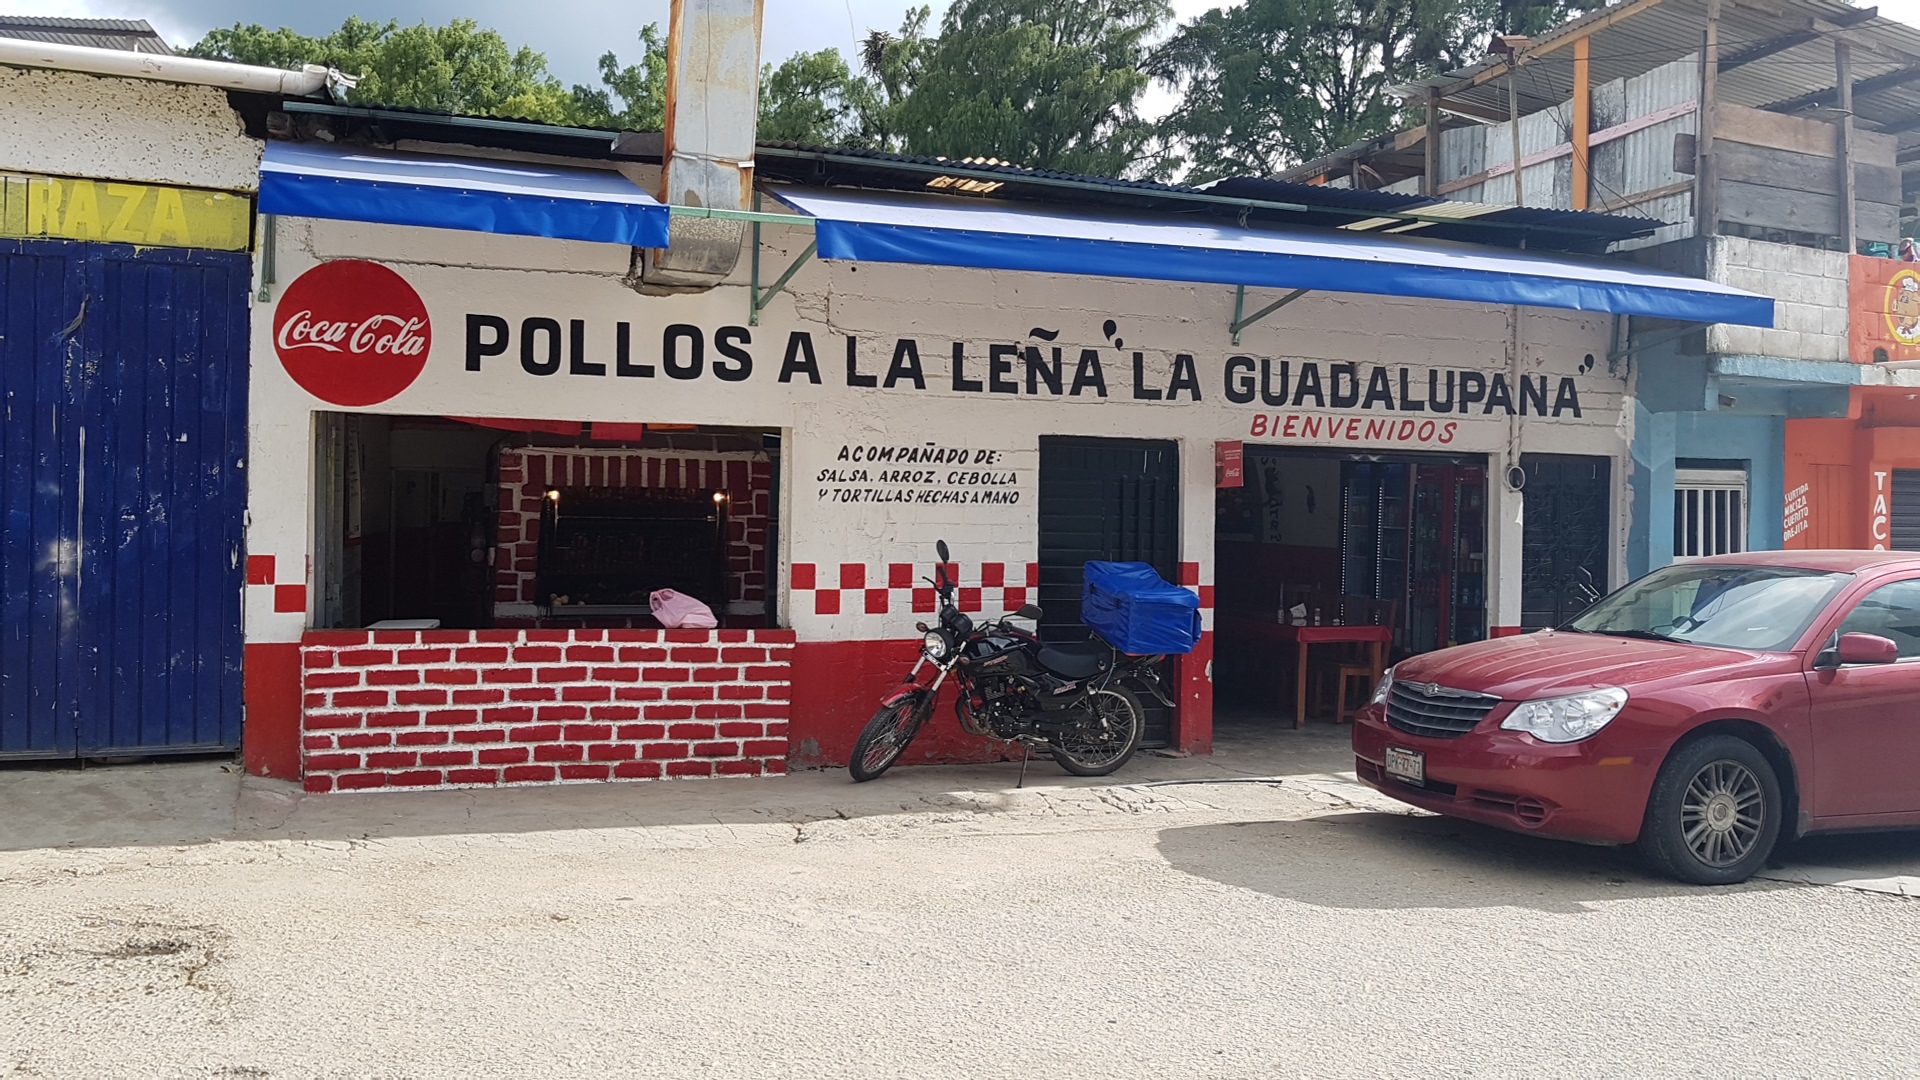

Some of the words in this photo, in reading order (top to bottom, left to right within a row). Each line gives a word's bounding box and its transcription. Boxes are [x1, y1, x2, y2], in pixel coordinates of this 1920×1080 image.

[28, 178, 191, 245] RAZA
[278, 310, 429, 356] Coca-Cola
[465, 313, 753, 382] POLLOS
[778, 331, 822, 385] A
[846, 336, 926, 390] LA
[952, 327, 1108, 398] LEÑA
[1250, 414, 1458, 445] BIENVENIDOS
[837, 442, 969, 465] ACOMPAÑADO
[973, 449, 1002, 465] DE:
[947, 471, 1018, 485] CEBOLLA
[818, 488, 829, 501] Y
[832, 488, 914, 503] TORTILLAS
[914, 490, 969, 504] HECHAS
[970, 491, 980, 504] A
[980, 490, 1020, 505] MANO
[1784, 495, 1807, 517] MACIZA
[1783, 506, 1809, 529] CUERITO
[1783, 520, 1808, 541] OREJITA
